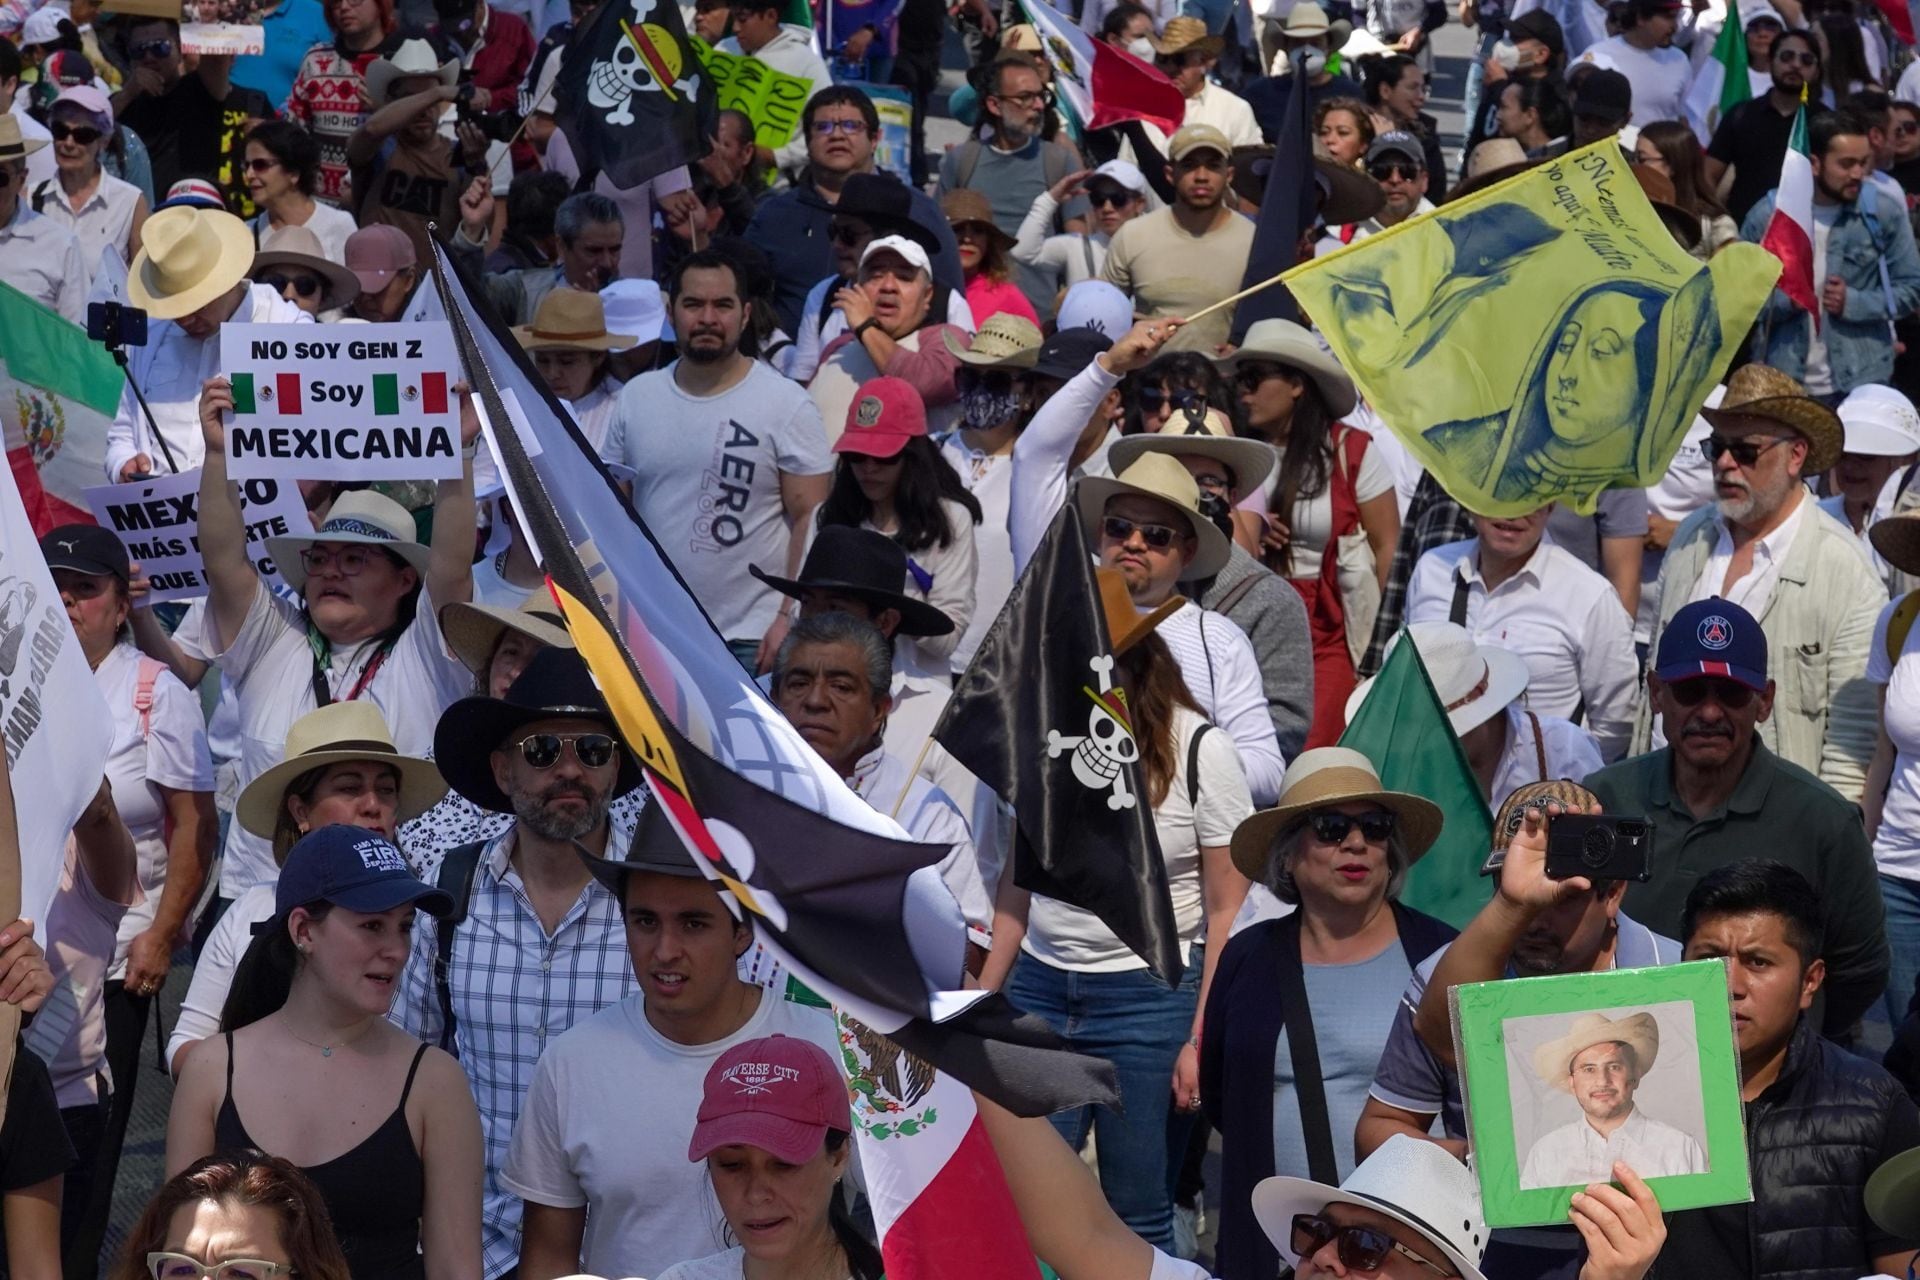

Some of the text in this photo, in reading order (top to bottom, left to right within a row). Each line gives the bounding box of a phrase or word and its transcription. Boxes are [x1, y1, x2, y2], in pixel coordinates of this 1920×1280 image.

[323, 115, 340, 127] HO
[756, 79, 806, 144] QUE
[380, 169, 449, 214] CAT
[251, 341, 288, 360] NO
[295, 342, 341, 360] SOY
[405, 340, 423, 359] Z
[310, 381, 364, 407] Soy
[232, 426, 454, 460] MEXICANA
[711, 418, 760, 547] AERO
[106, 478, 278, 532] MÉXO
[128, 536, 187, 561] MÁS
[149, 571, 200, 591] QUE
[359, 847, 399, 862] FIR
[773, 1065, 800, 1082] CITY
